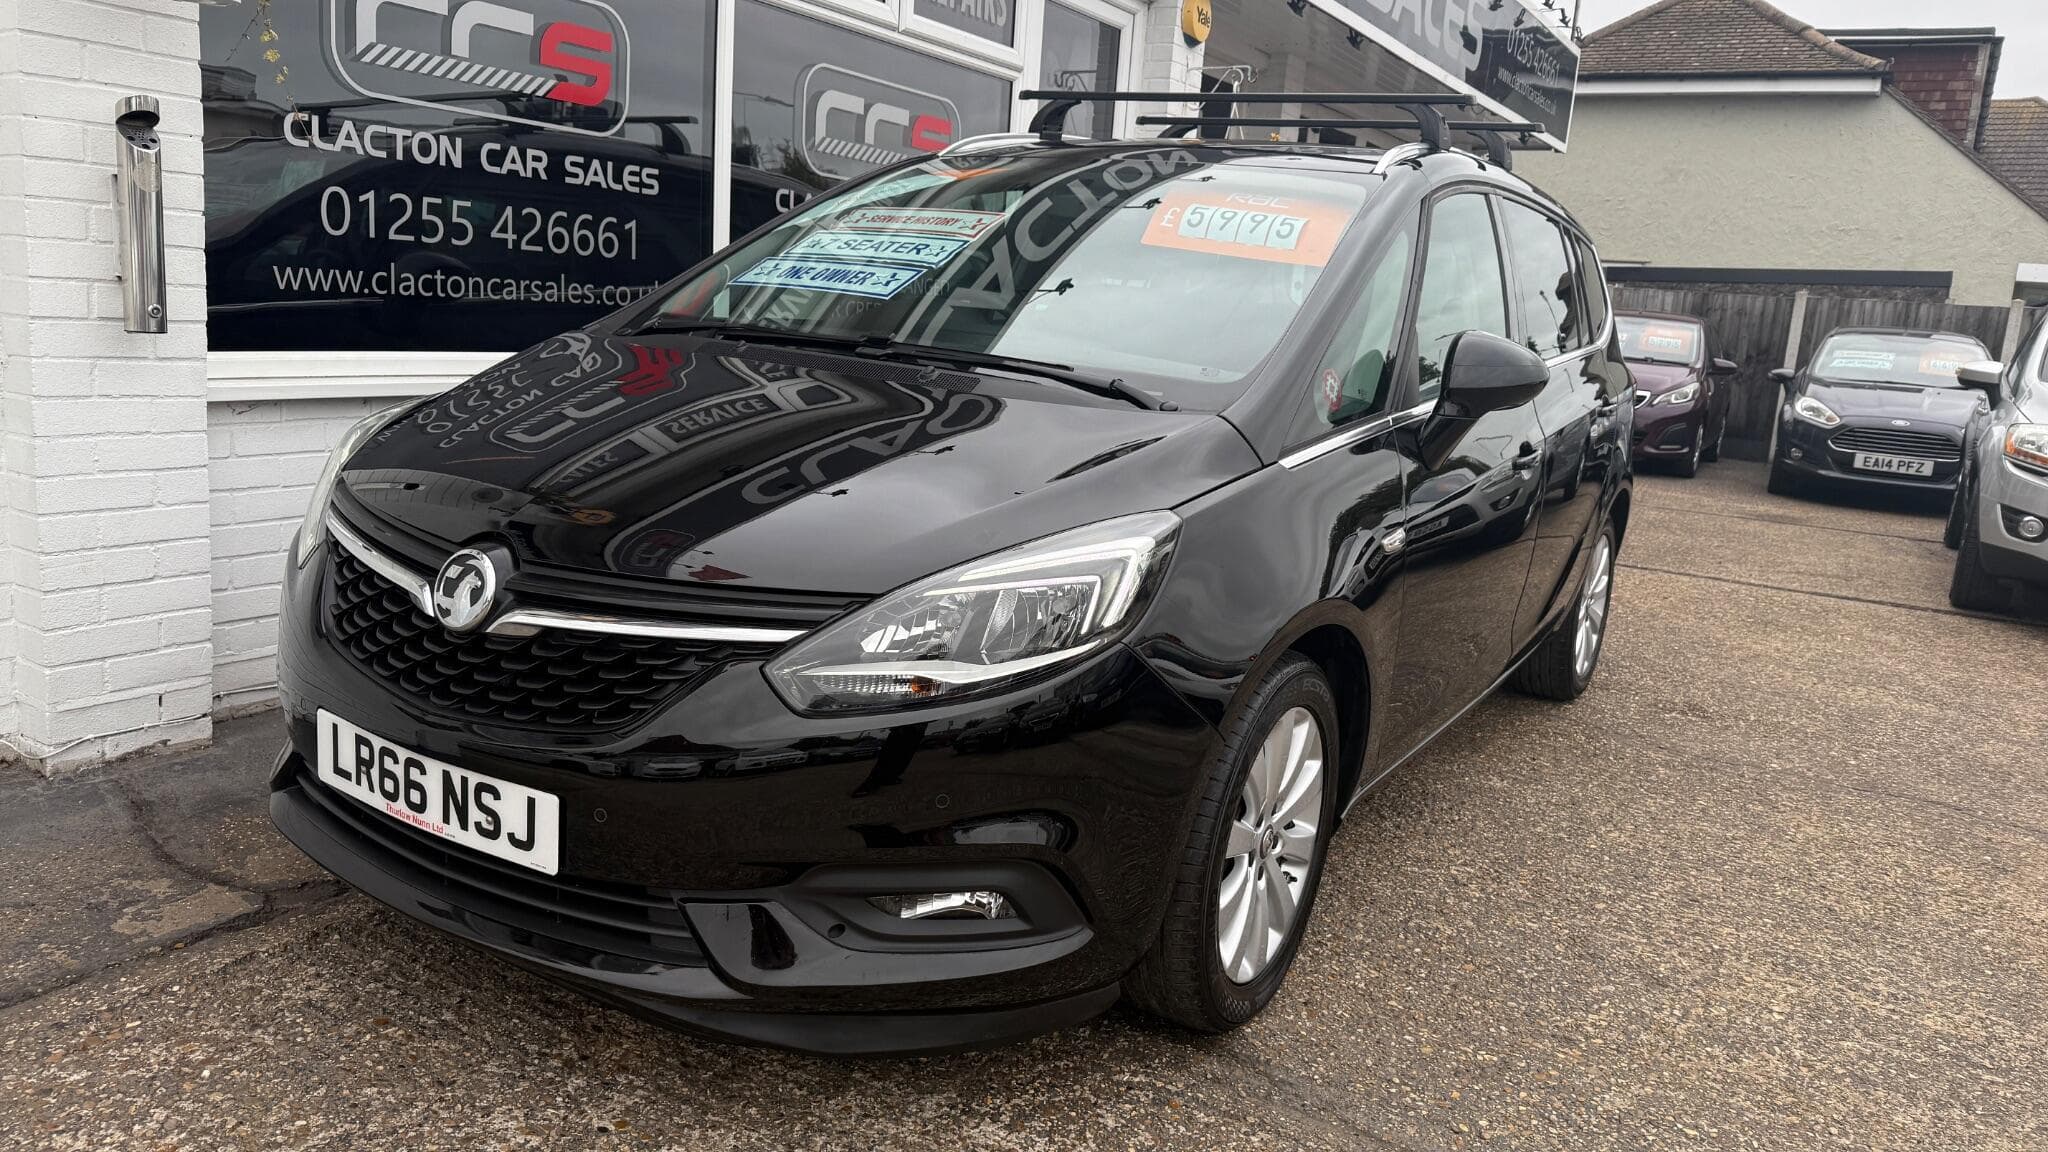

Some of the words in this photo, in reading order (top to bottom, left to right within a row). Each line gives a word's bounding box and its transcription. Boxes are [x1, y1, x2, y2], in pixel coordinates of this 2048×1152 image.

[1197, 5, 1211, 29] Yale
[1507, 26, 1535, 68] 01255
[1533, 45, 1560, 86] 426661
[283, 112, 464, 169] CLACTON
[480, 142, 548, 180] CAR
[564, 155, 660, 196] SALES
[320, 185, 474, 247] 01255
[490, 205, 639, 260] 426661
[867, 214, 913, 225] SERVICE
[913, 216, 961, 227] HISTORY
[819, 237, 836, 250] 7
[837, 238, 931, 256] SEATER
[273, 262, 660, 307] www.clactoncarsales.co
[779, 265, 812, 281] ONE
[812, 267, 874, 286] OWNER
[1863, 456, 1893, 470] EA14
[1897, 460, 1926, 474] PFZ
[331, 723, 428, 814] LR66
[441, 769, 536, 852] NSJ
[386, 803, 411, 822] Thurlow
[412, 815, 431, 831] Nunn
[432, 822, 444, 835] Ltd
